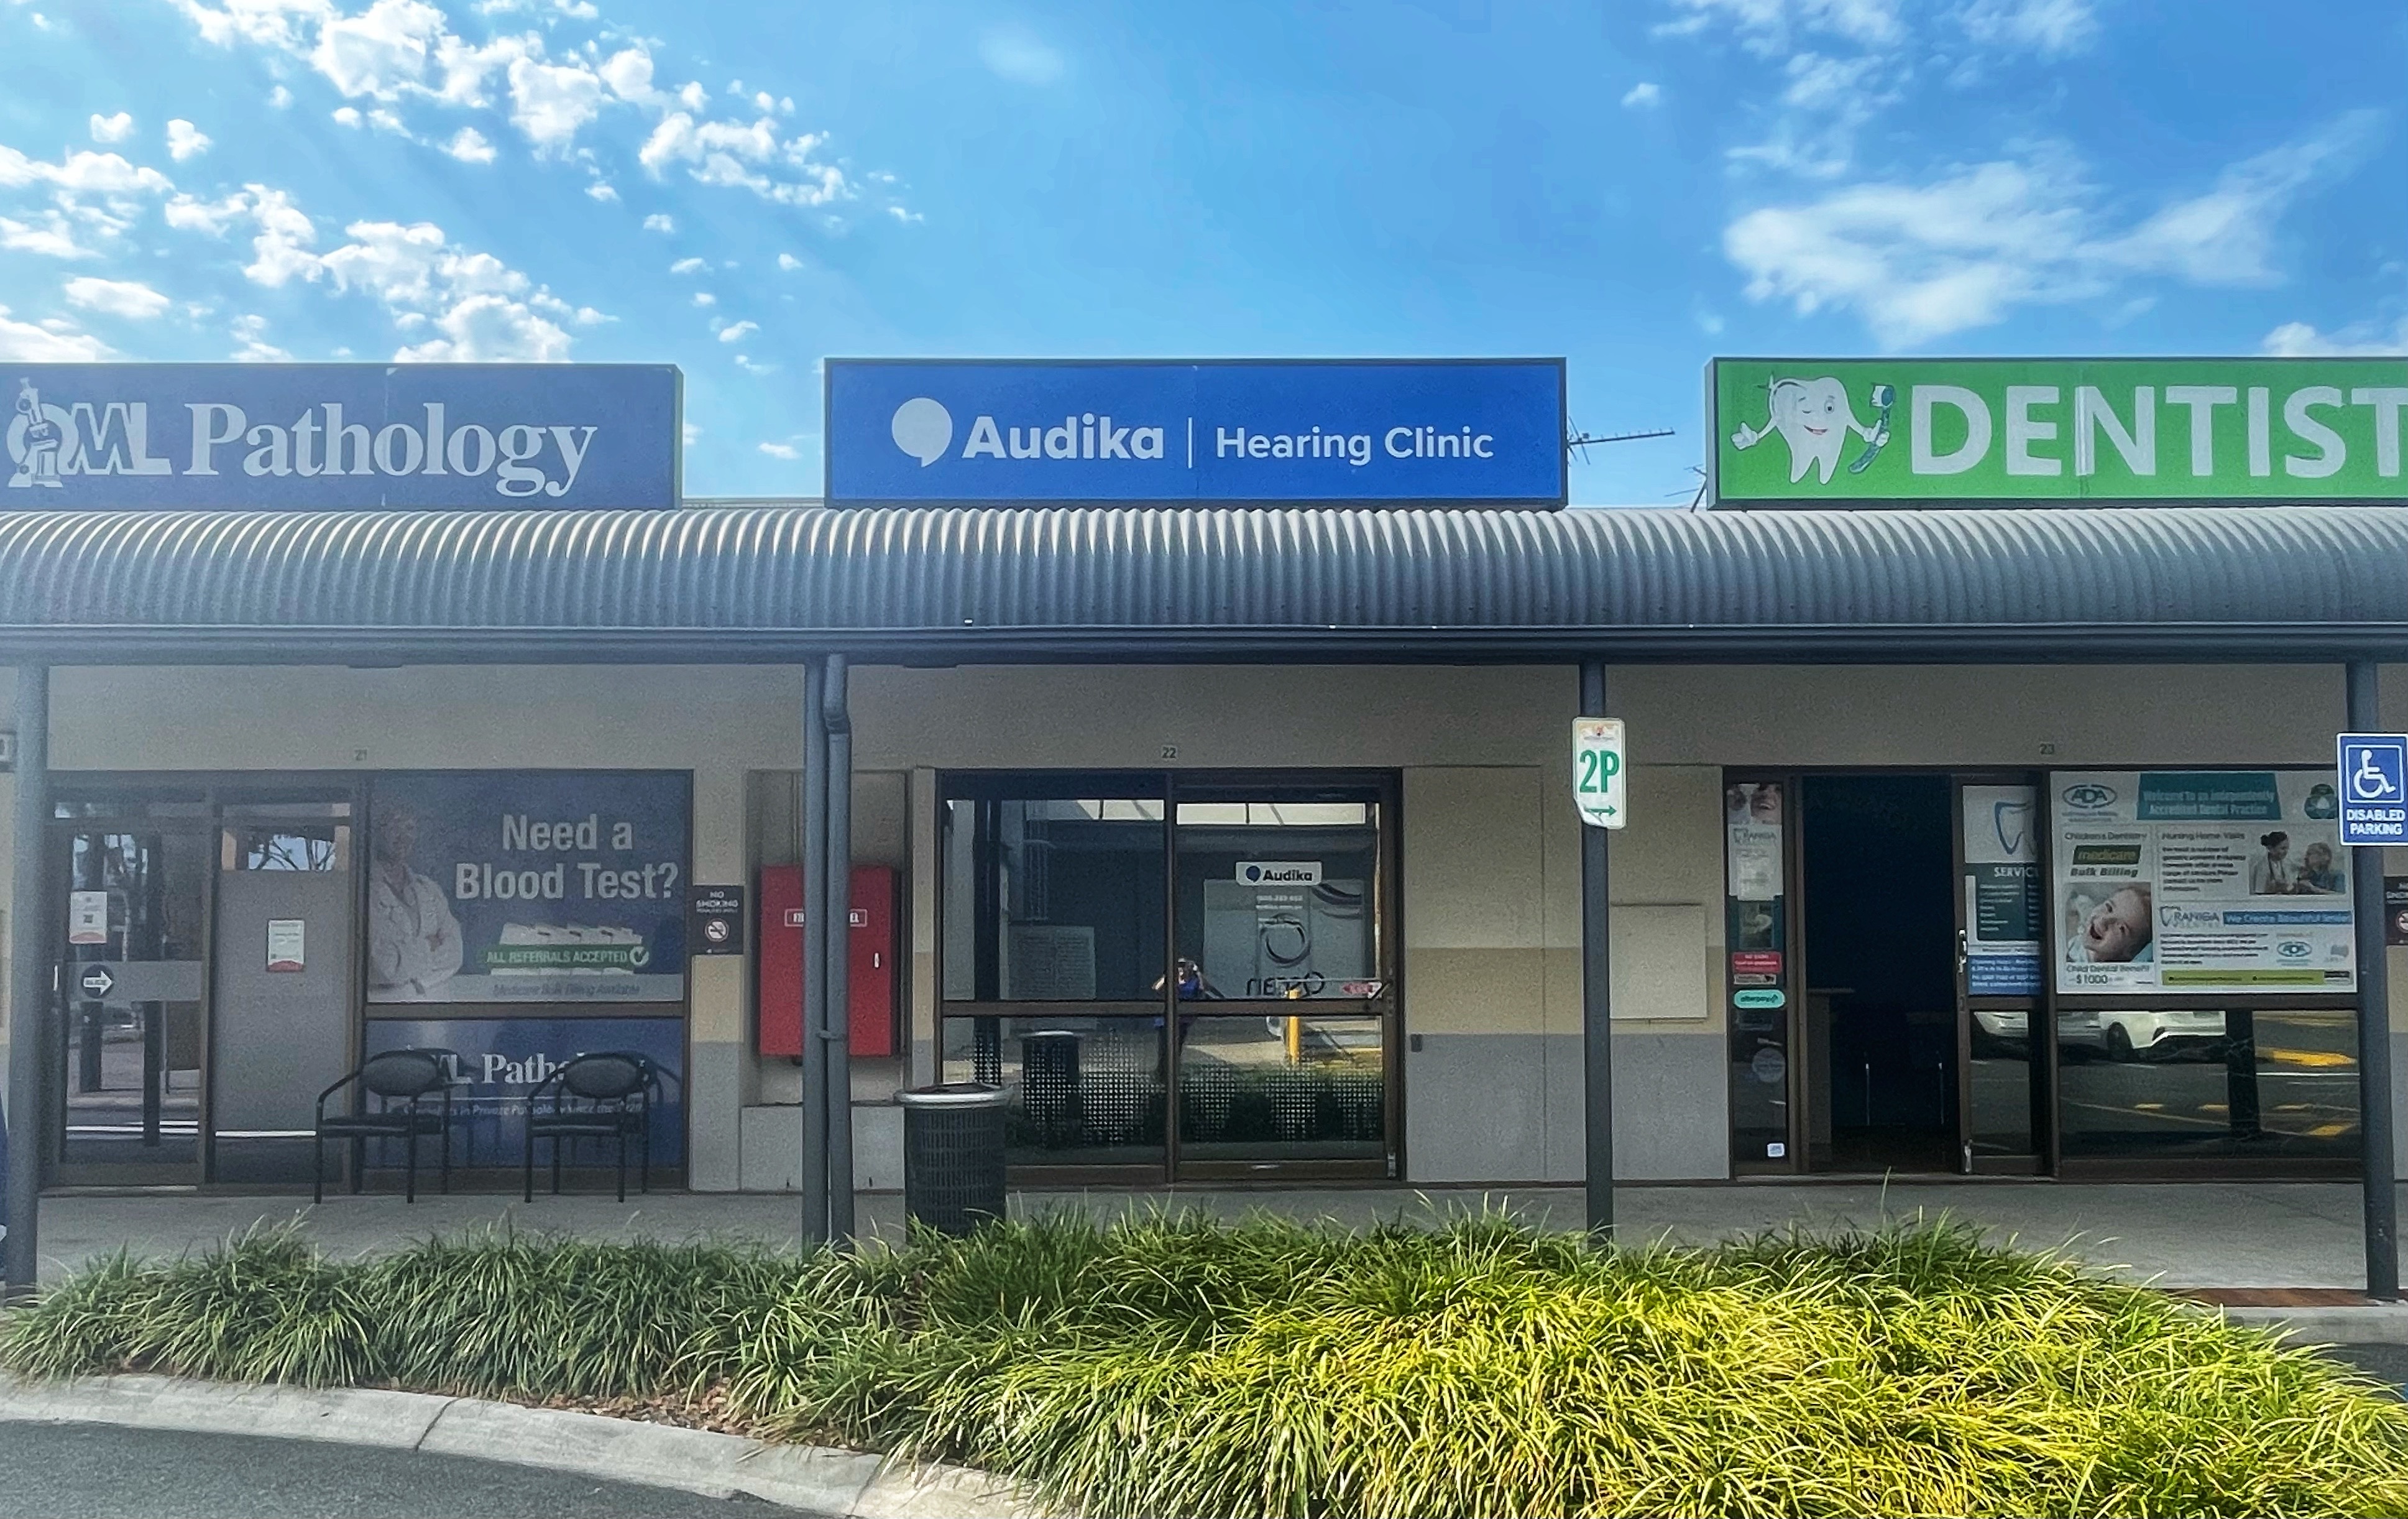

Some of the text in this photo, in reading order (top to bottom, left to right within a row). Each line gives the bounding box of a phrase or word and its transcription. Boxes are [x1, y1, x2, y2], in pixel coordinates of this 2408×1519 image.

[1911, 384, 2408, 479] DENTIST
[962, 412, 1494, 466] Audika Hearing Clinic
[182, 401, 597, 497] Pathology
[354, 749, 368, 761] 21
[1162, 747, 1177, 759] 22
[2040, 744, 2054, 755] 23
[1579, 750, 1619, 793] 2P
[2072, 788, 2108, 803] ADA
[2346, 809, 2406, 821] DISABLED
[502, 813, 633, 851] Need a
[2350, 823, 2403, 835] PARKING
[456, 862, 679, 900] Blood Test?
[1262, 869, 1313, 882] Audika
[709, 890, 724, 898] NO
[696, 899, 738, 907] SMOKING
[487, 950, 628, 963] ALL REFERRALS ACCEPTED
